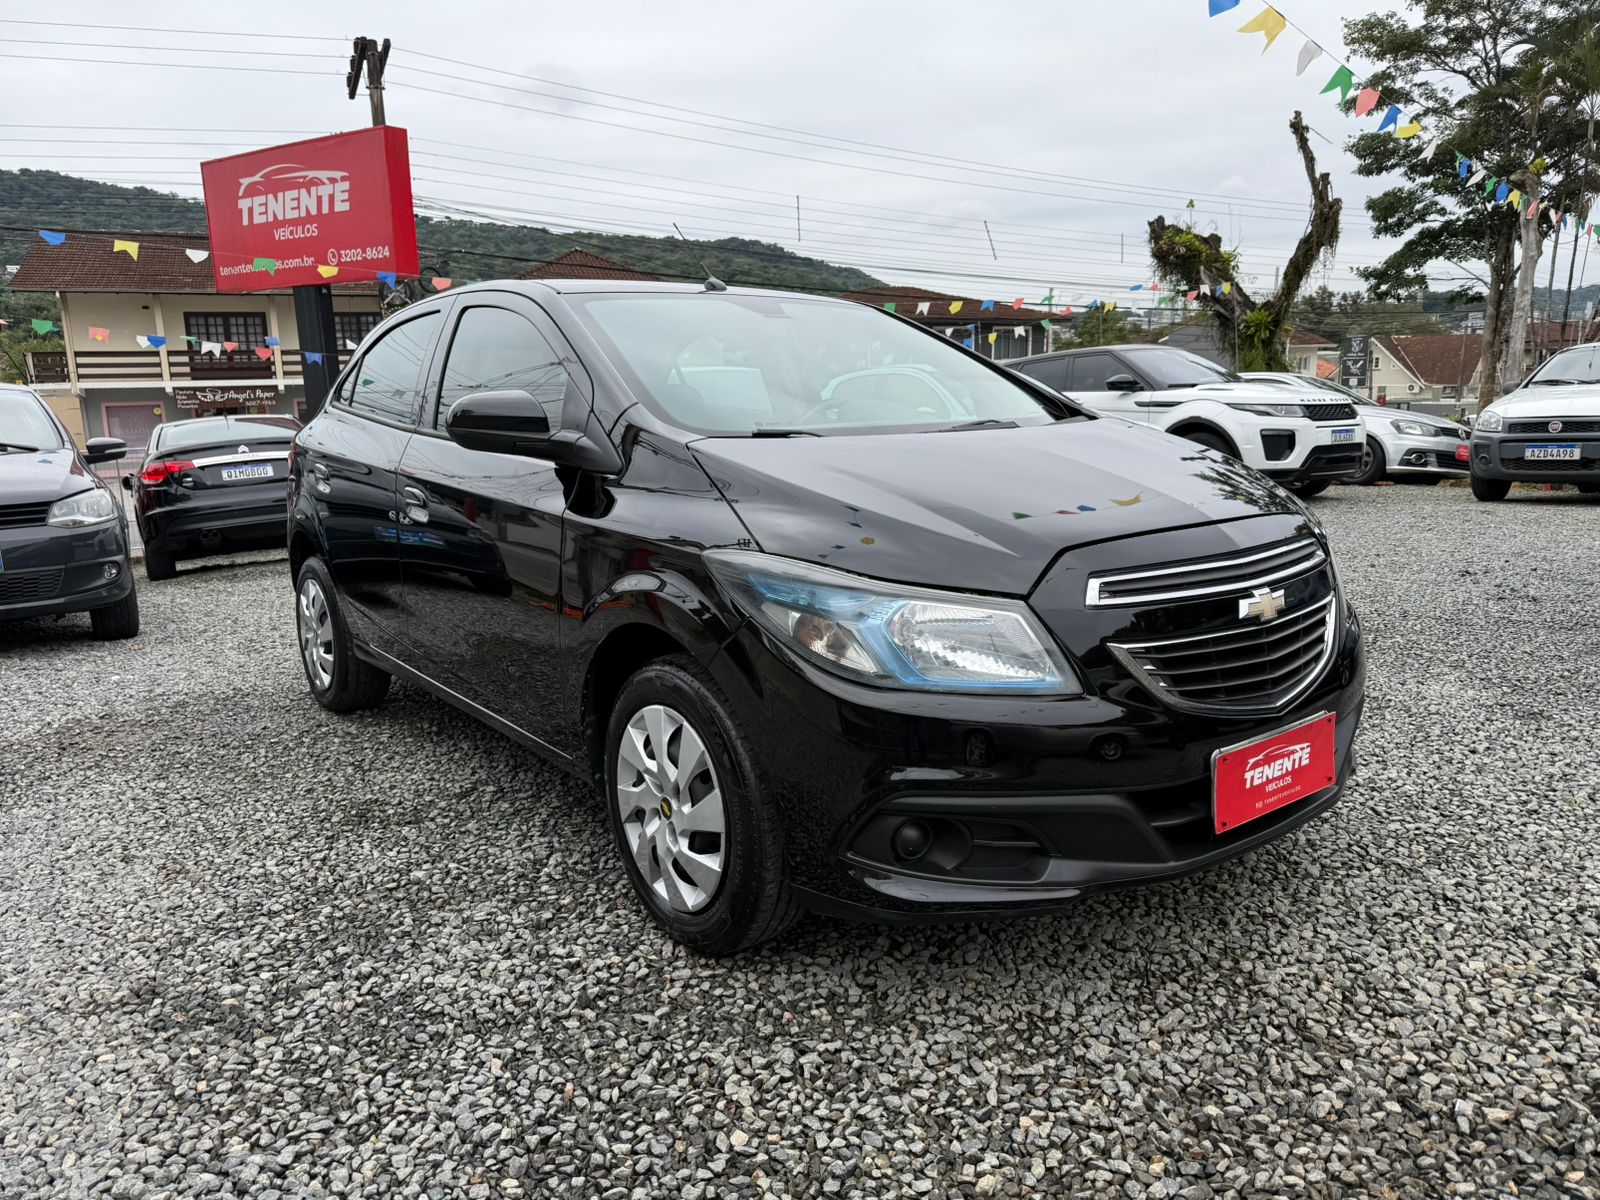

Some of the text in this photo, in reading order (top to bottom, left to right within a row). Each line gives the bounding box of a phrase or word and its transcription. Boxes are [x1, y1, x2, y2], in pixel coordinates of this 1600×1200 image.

[238, 181, 350, 226] TENENTE
[274, 223, 318, 241] VEÍCULOS
[340, 246, 390, 263] 3202-8624
[228, 389, 275, 403] Angel's Paper
[1530, 449, 1575, 459] AZD4A98
[1244, 746, 1311, 789] TENENTE
